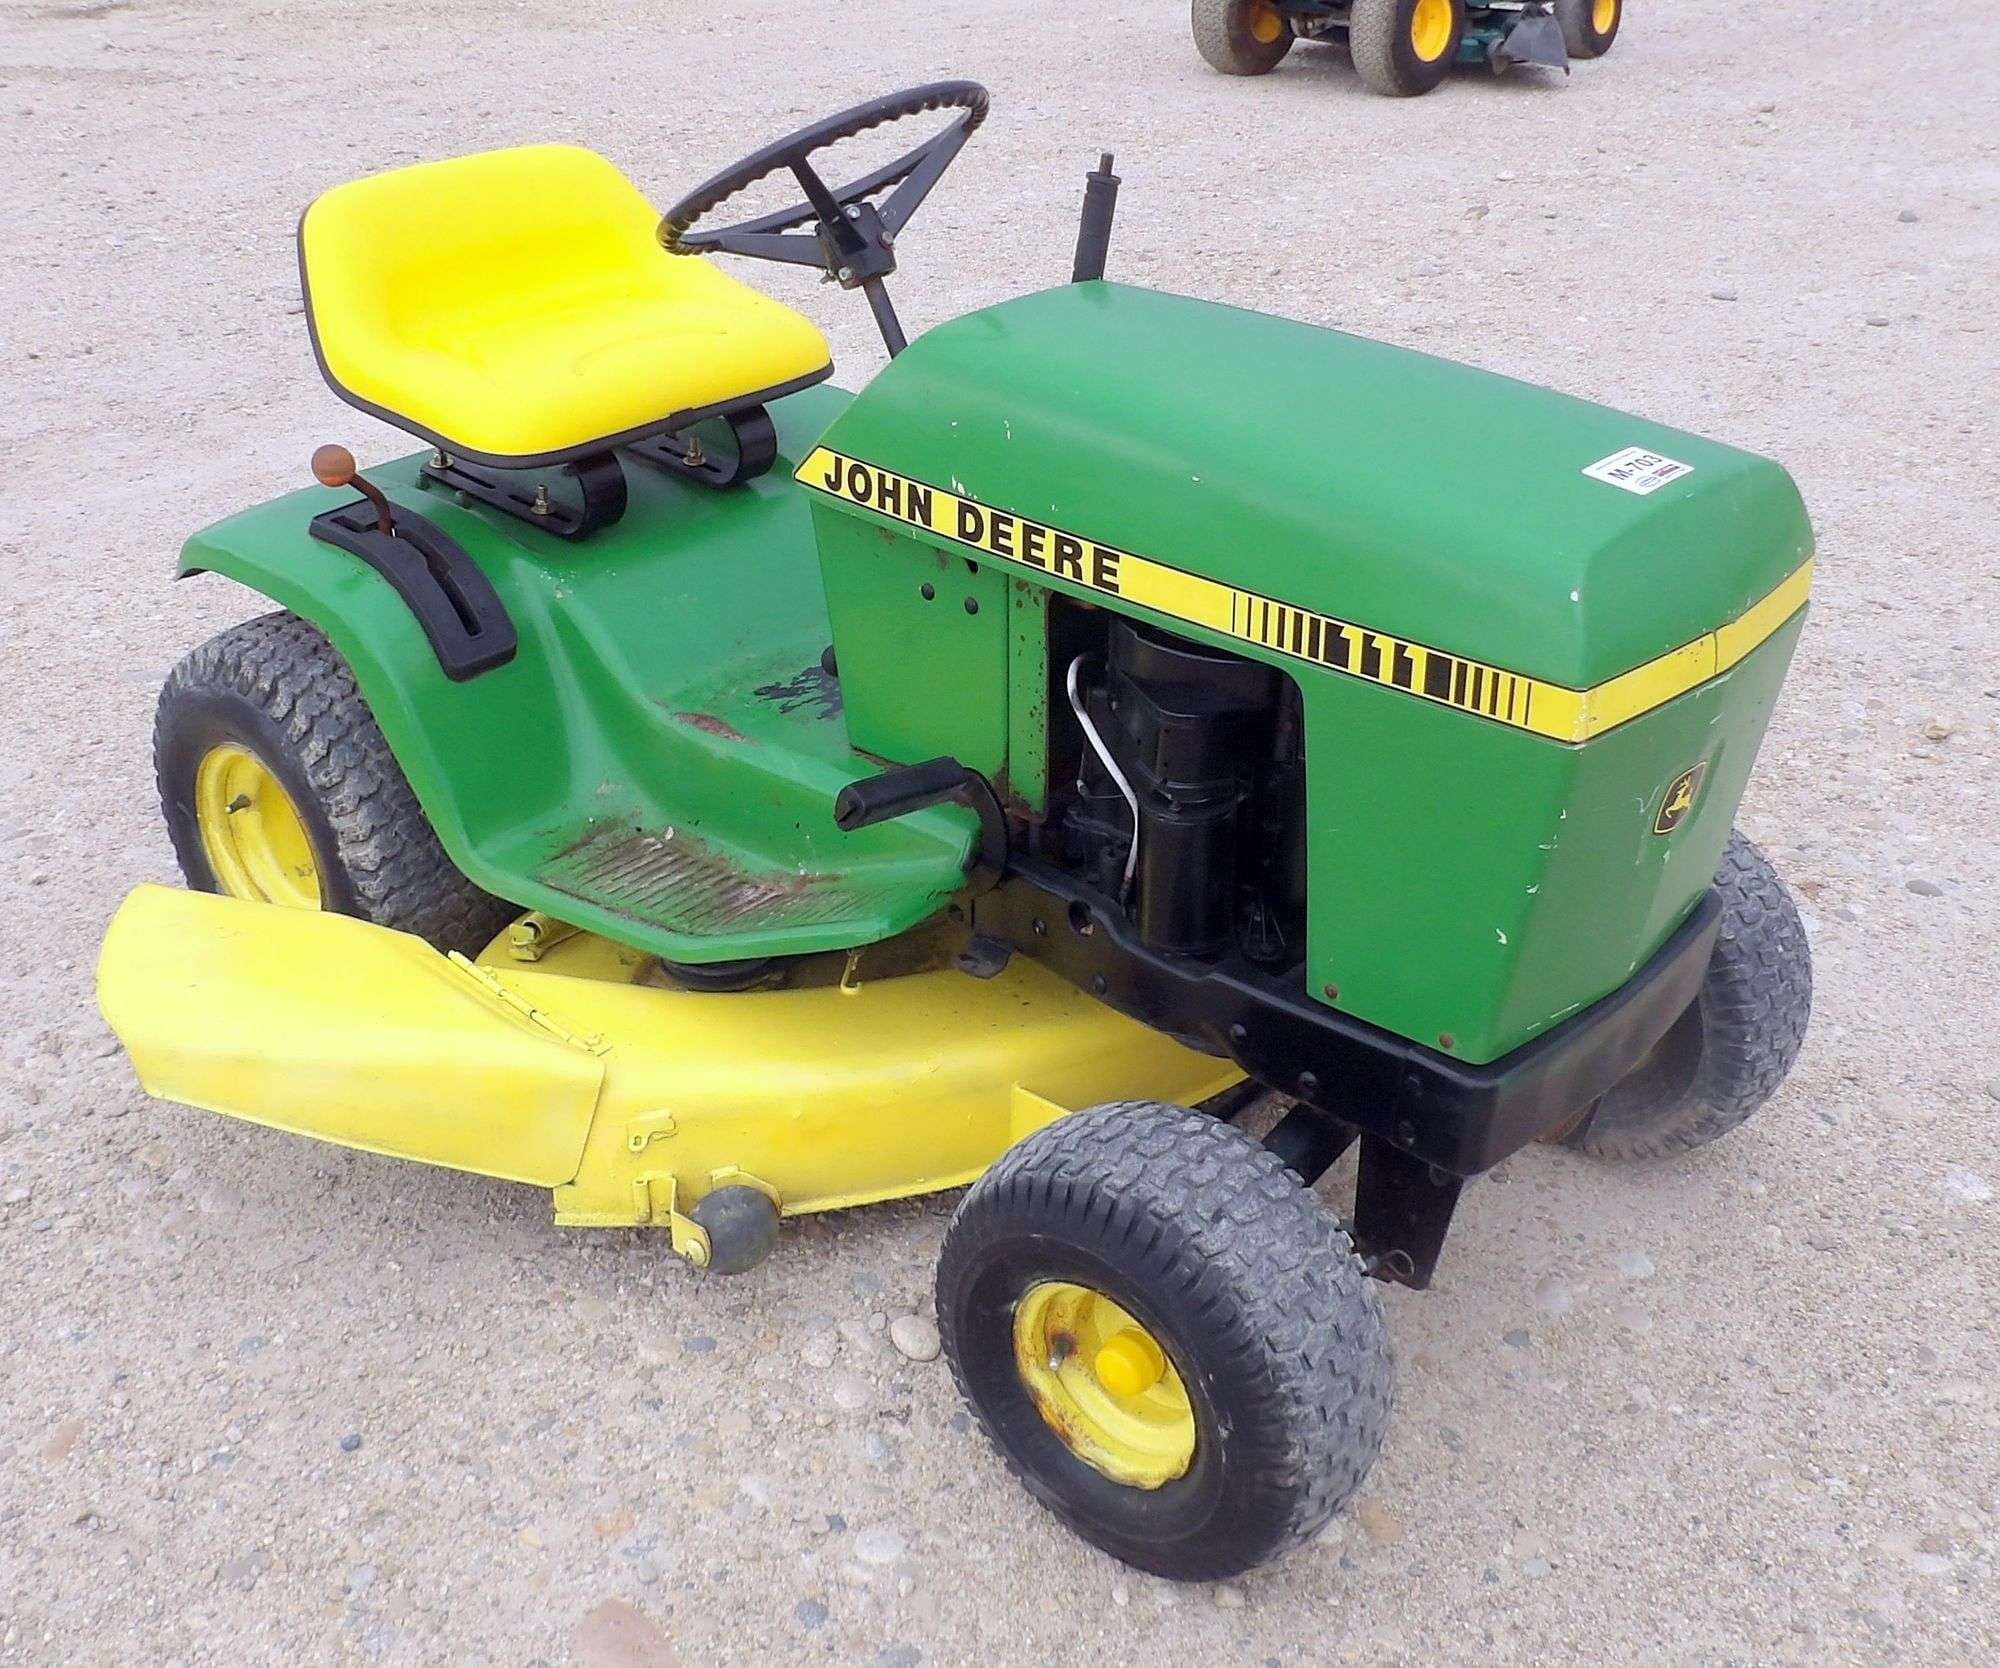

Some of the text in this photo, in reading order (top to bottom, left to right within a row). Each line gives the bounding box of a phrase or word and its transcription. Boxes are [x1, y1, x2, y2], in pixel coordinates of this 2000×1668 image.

[1607, 454, 1662, 480] M-703
[824, 456, 1120, 594] JOHN DEERE
[1339, 624, 1428, 694] 111
